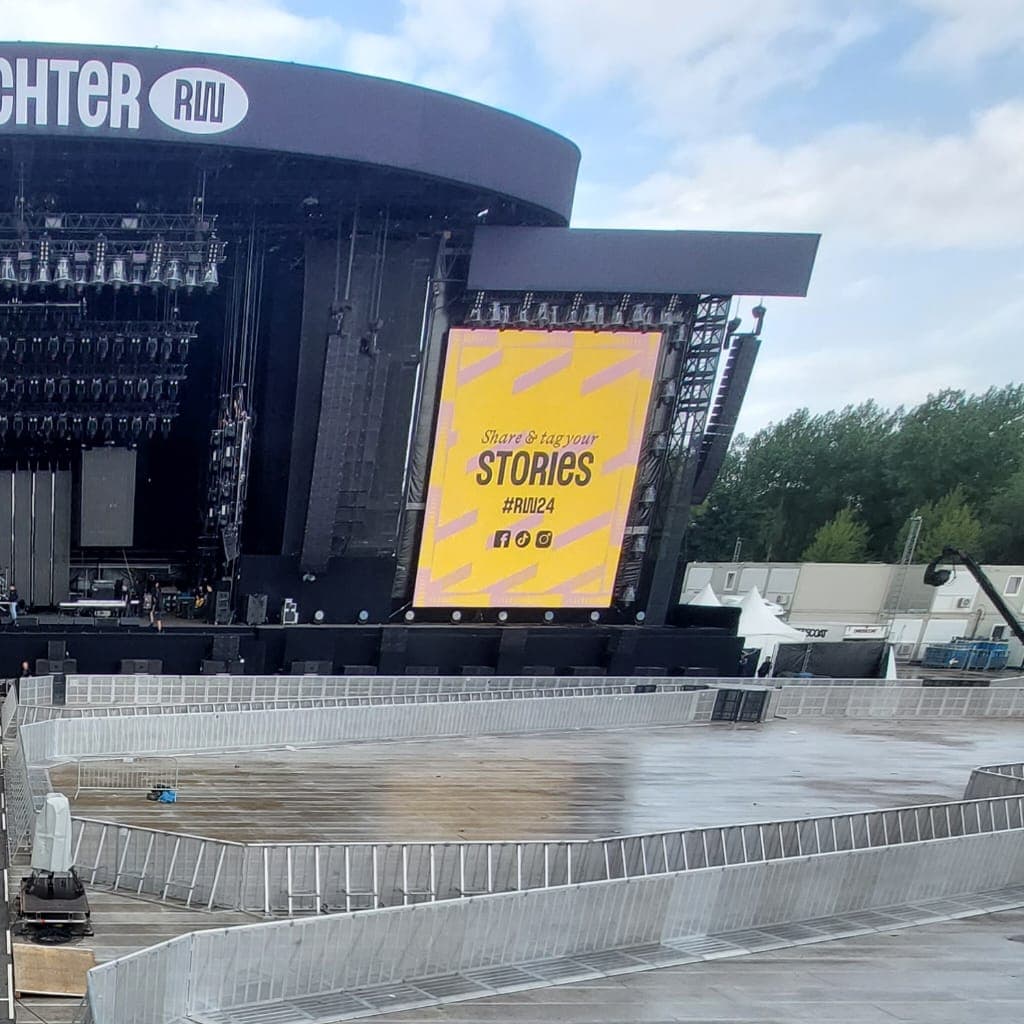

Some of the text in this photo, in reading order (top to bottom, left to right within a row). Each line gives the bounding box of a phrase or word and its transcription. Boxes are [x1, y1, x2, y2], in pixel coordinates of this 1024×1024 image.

[481, 429, 599, 448] Share & tag your
[502, 497, 555, 514] #RW24
